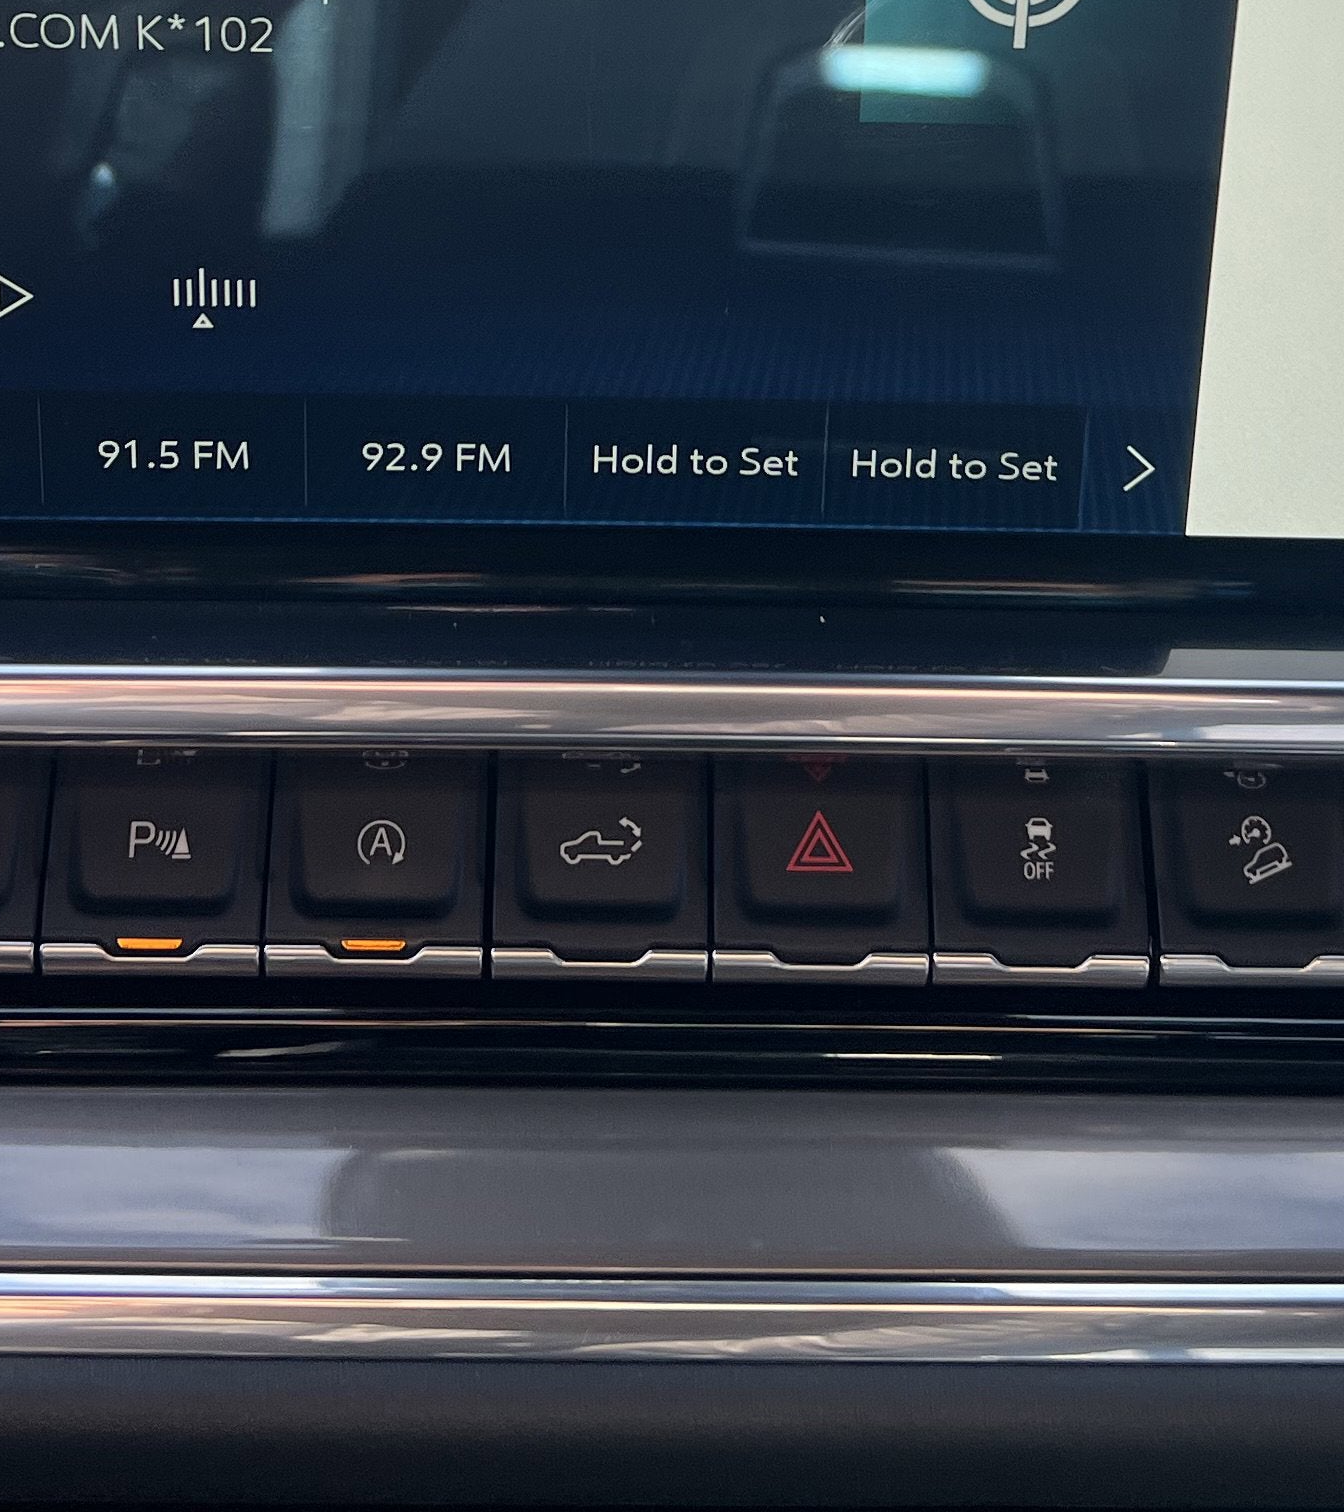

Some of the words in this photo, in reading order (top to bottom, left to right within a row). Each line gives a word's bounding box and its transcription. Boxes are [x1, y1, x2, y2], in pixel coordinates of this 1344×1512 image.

[98, 439, 179, 469] 91.5
[193, 440, 249, 470] FM
[362, 442, 443, 472] 92.9
[456, 443, 511, 473] FM
[593, 443, 678, 475] Hold
[689, 448, 728, 475] to
[739, 447, 799, 477] Set
[852, 447, 937, 479] Hold
[948, 453, 987, 480] to
[998, 451, 1058, 481] Set
[1023, 862, 1055, 881] OFF
